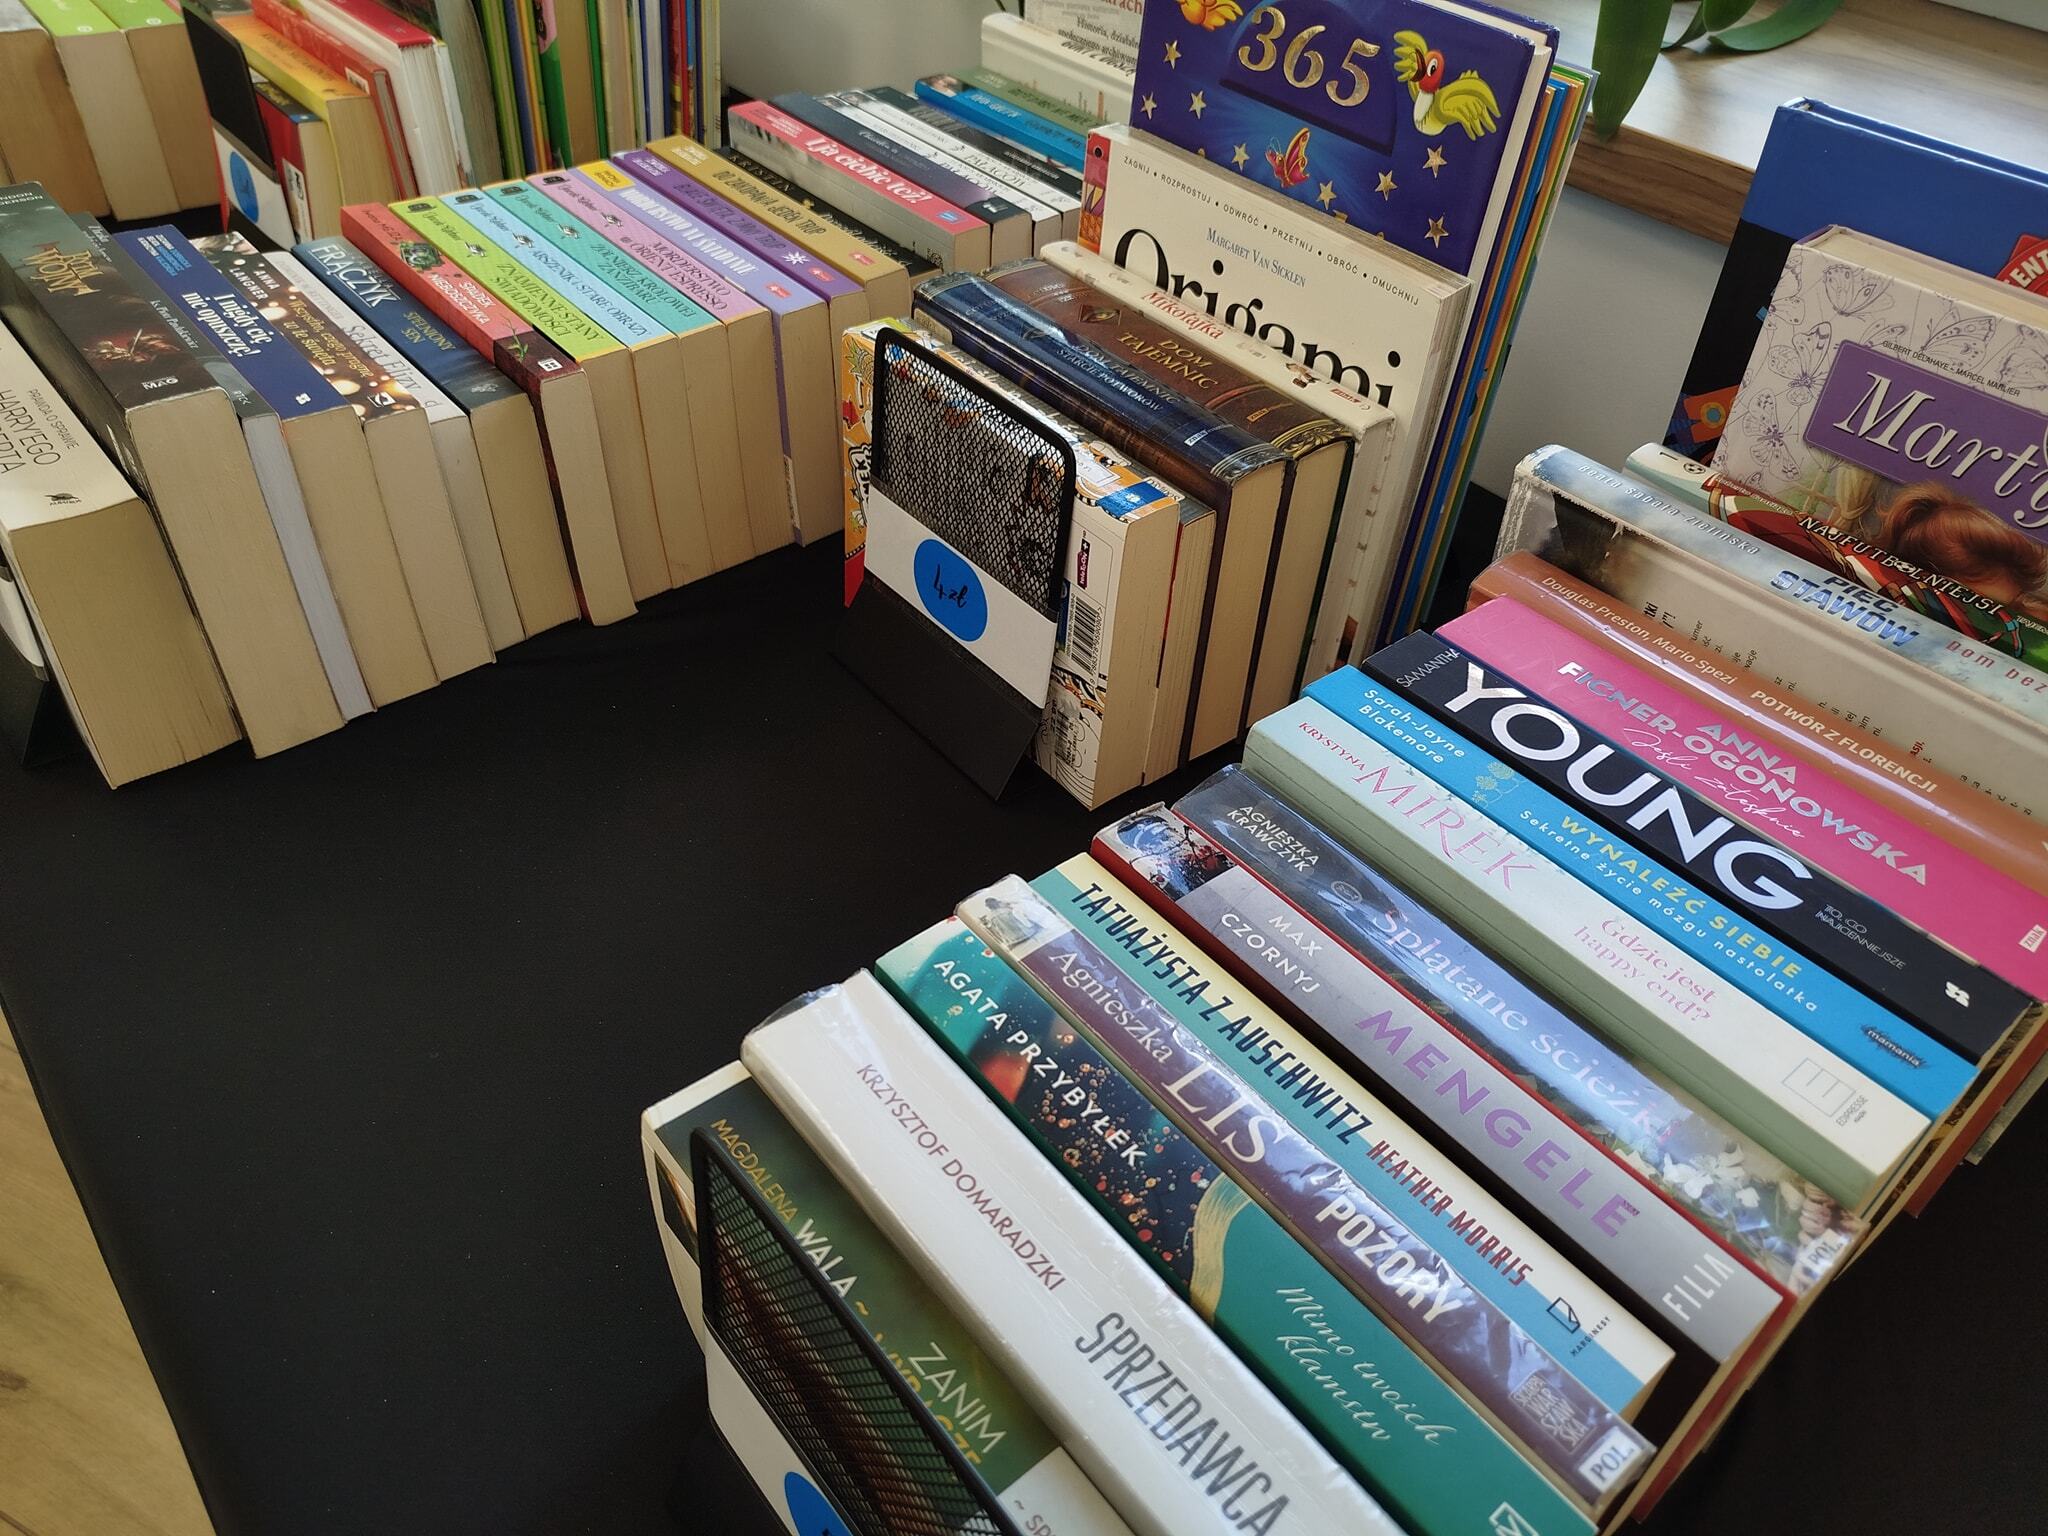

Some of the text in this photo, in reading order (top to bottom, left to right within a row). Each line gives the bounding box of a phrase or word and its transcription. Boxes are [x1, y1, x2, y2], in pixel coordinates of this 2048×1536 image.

[1237, 5, 1379, 106] 365
[770, 201, 801, 224] JEDEN
[795, 216, 826, 236] TRUP
[886, 179, 933, 203] też!
[22, 246, 102, 297] WOJNY
[56, 249, 104, 284] RYTM
[228, 267, 269, 301] LANGNER
[253, 270, 281, 291] ANNA
[311, 243, 398, 308] FRĄCZYK
[630, 242, 674, 275] ORIENT
[671, 267, 729, 311] ESPRESSO
[652, 241, 731, 297] MORDERSTWO
[1206, 226, 1306, 288] MARGARET VAN SICKLEN
[1223, 203, 1260, 226] ODWRÓĆ
[1271, 227, 1313, 253] PRZETNIJ
[1326, 253, 1358, 274] OBRÓĆ
[1372, 276, 1419, 306] DMUCHNIJ
[214, 293, 236, 302] I
[219, 299, 259, 328] nigdy
[428, 273, 491, 325] NIEBOSZCZYKA
[459, 280, 496, 308] SPADEK
[491, 275, 570, 337] ŚWIADOMOŚCI
[497, 263, 604, 342] ZNAMIENNE STANY
[532, 249, 577, 285] ARSZENIK
[579, 281, 612, 311] STARE
[604, 303, 650, 338] OBRAZY
[1142, 290, 1224, 340] Mikołajka
[197, 308, 262, 358] opuszczę!
[284, 320, 336, 367] w te święta
[287, 300, 374, 378] Wszystko, czego pragnę
[343, 324, 422, 393] Sekret Elizy
[401, 327, 424, 345] SEN
[403, 311, 456, 351] SPEŁNIONY
[1117, 332, 1219, 390] TAJEMNIC
[1158, 340, 1212, 368] DOM
[1058, 349, 1100, 378] STARCIE
[1074, 343, 1181, 404] DOM TAJEMNIC
[1882, 340, 2021, 398] GILBERT DELAHAYE MARCEL MARLIER
[0, 389, 61, 466] HARRY'EGO
[28, 388, 51, 414] PRAWDA
[51, 420, 80, 449] SPRAWIE
[1541, 576, 1596, 612] Douglas
[1595, 605, 1650, 645] Preston,
[1652, 637, 1696, 665] Mario
[1695, 659, 1739, 686] Spezi
[1395, 647, 1461, 689] SAMANTHA
[1298, 720, 1366, 772] KRYSTYNA
[1357, 704, 1446, 765] Blakemore
[1363, 687, 1466, 759] Sarah-Jayne
[1622, 727, 1693, 771] Jeśli
[1697, 723, 1798, 785] ANNA
[1750, 690, 1825, 735] POTWÓR
[1822, 727, 1841, 742] Z
[1837, 736, 1938, 794] FLORENCJI
[1443, 661, 1813, 911] YOUNG
[1557, 661, 1927, 887] FICNER-OGONOWSKA
[1227, 809, 1313, 873] KRAWCZYK
[1239, 805, 1320, 866] AGNIESZKA
[1351, 764, 1537, 892] MIREK
[1519, 809, 1820, 1014] Sekretne życie mózgu nastolatka
[1559, 815, 1804, 980] WYNALEŹĆ SIEBIE
[1220, 912, 1321, 994] CZORNYJ
[1267, 915, 1323, 958] MAX
[1372, 906, 1529, 1031] Splątane
[1601, 916, 1719, 1004] Gdzie jest
[1573, 925, 1714, 1024] happy end?
[1071, 881, 1374, 1146] TATUAŻYSTA Z AUSCHWITZ
[933, 959, 1148, 1167] AGATA PRZYBYŁEK
[1048, 951, 1286, 1165] Agnieszka LIS
[1866, 1027, 1922, 1069] mamania
[1354, 1008, 1639, 1239] MENGELE
[710, 1118, 858, 1299] MAGDALENA WALA
[856, 1062, 1067, 1291] KRZYSZTOF DOMARADZKI
[1365, 1139, 1534, 1288] HEATHER MORRIS
[1314, 1196, 1463, 1326] POZORY
[1662, 1251, 1735, 1322] FILIA
[1275, 1286, 1458, 1448] Mimo twoich
[1570, 1315, 1611, 1357] MARGINESY
[908, 1341, 1008, 1454] ZANIM
[1074, 1311, 1291, 1536] SPRZEDAWCA
